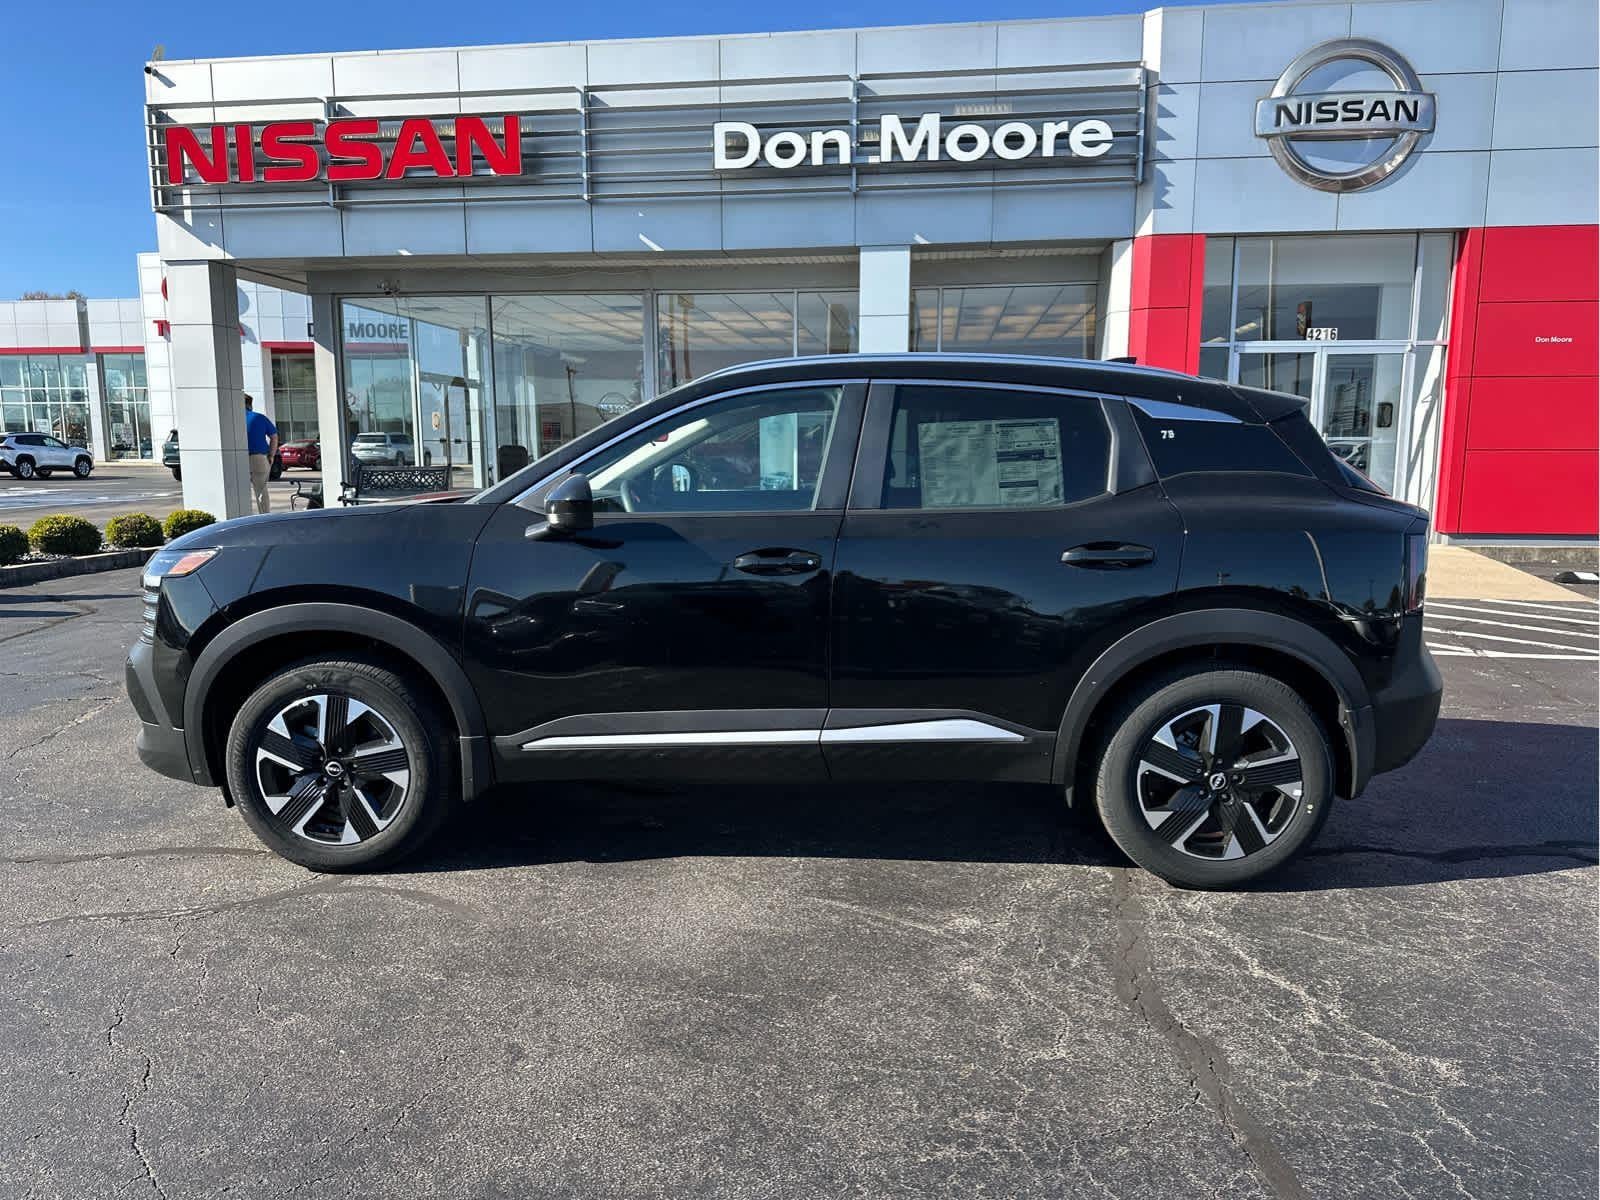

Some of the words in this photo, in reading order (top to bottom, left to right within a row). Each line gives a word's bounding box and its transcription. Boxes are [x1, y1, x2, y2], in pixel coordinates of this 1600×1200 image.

[1275, 99, 1419, 127] NISSAN
[165, 115, 522, 185] NISSAN
[713, 121, 852, 169] Don
[880, 112, 1114, 162] Moore
[349, 323, 409, 339] MOORE
[1307, 328, 1337, 340] 4216
